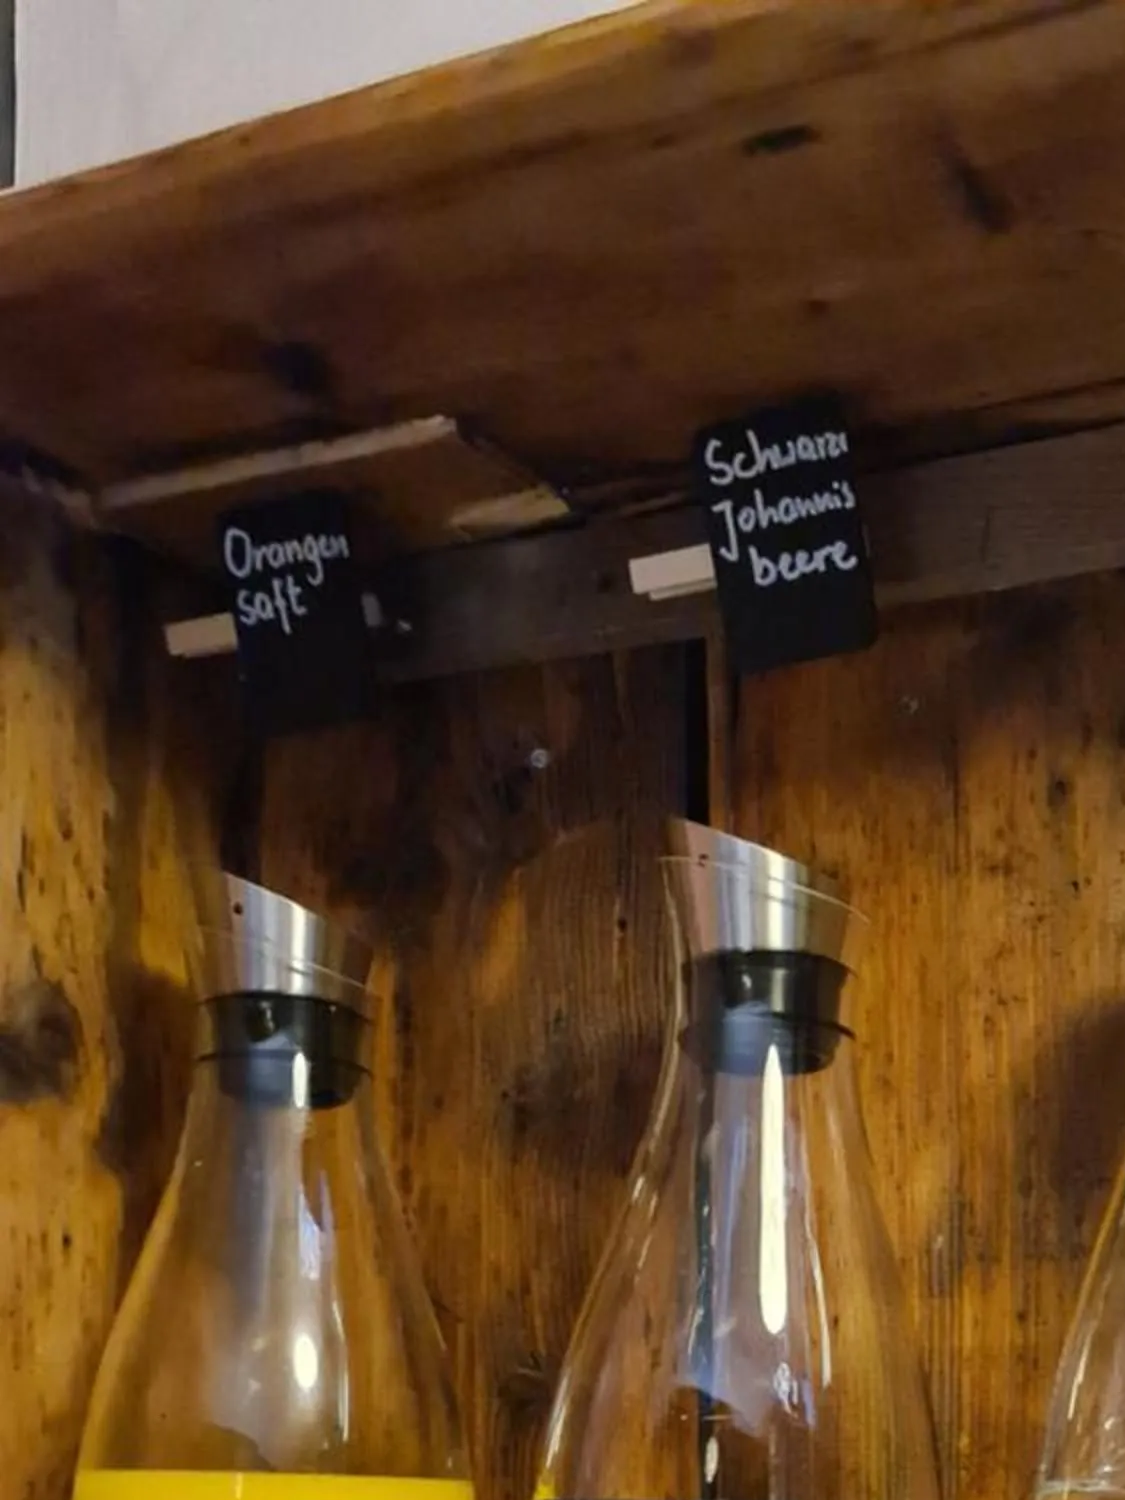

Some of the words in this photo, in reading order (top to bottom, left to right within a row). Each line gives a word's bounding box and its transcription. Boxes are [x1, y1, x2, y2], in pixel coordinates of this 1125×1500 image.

[711, 481, 856, 562] Johannis
[224, 526, 349, 586] Orangen
[749, 541, 858, 586] beere
